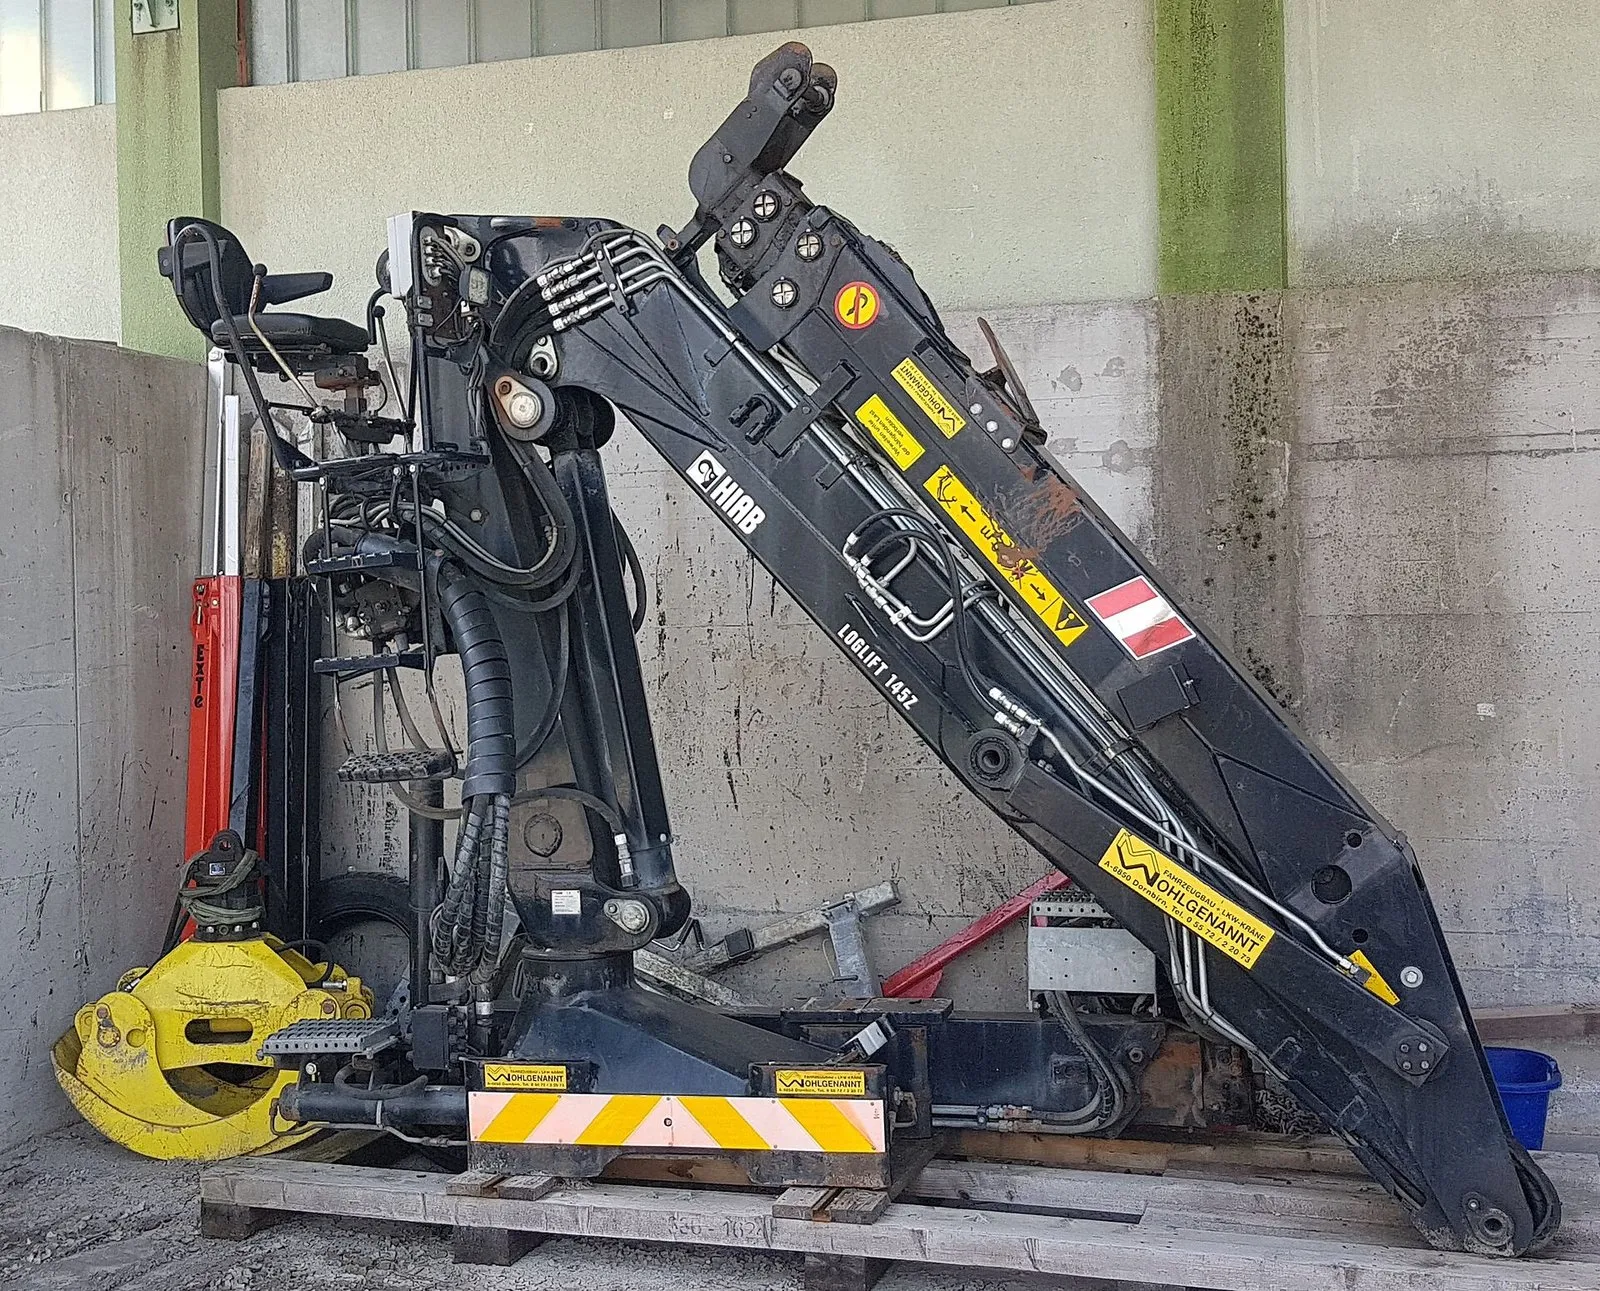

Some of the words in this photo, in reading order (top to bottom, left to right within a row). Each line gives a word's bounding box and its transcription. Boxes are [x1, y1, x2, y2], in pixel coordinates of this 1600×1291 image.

[710, 475, 766, 534] HIAB
[837, 623, 888, 676] LOGLIFT
[884, 673, 918, 710] 145Z
[1103, 860, 1131, 881] A-6850
[1170, 904, 1185, 919] Tel.
[1192, 920, 1204, 930] 55
[1204, 928, 1215, 939] 72
[1228, 945, 1239, 955] 20
[1240, 952, 1250, 963] 73
[1162, 869, 1216, 907] FAHRZEUGBAU
[1221, 908, 1265, 941] LKW-KRÄNE
